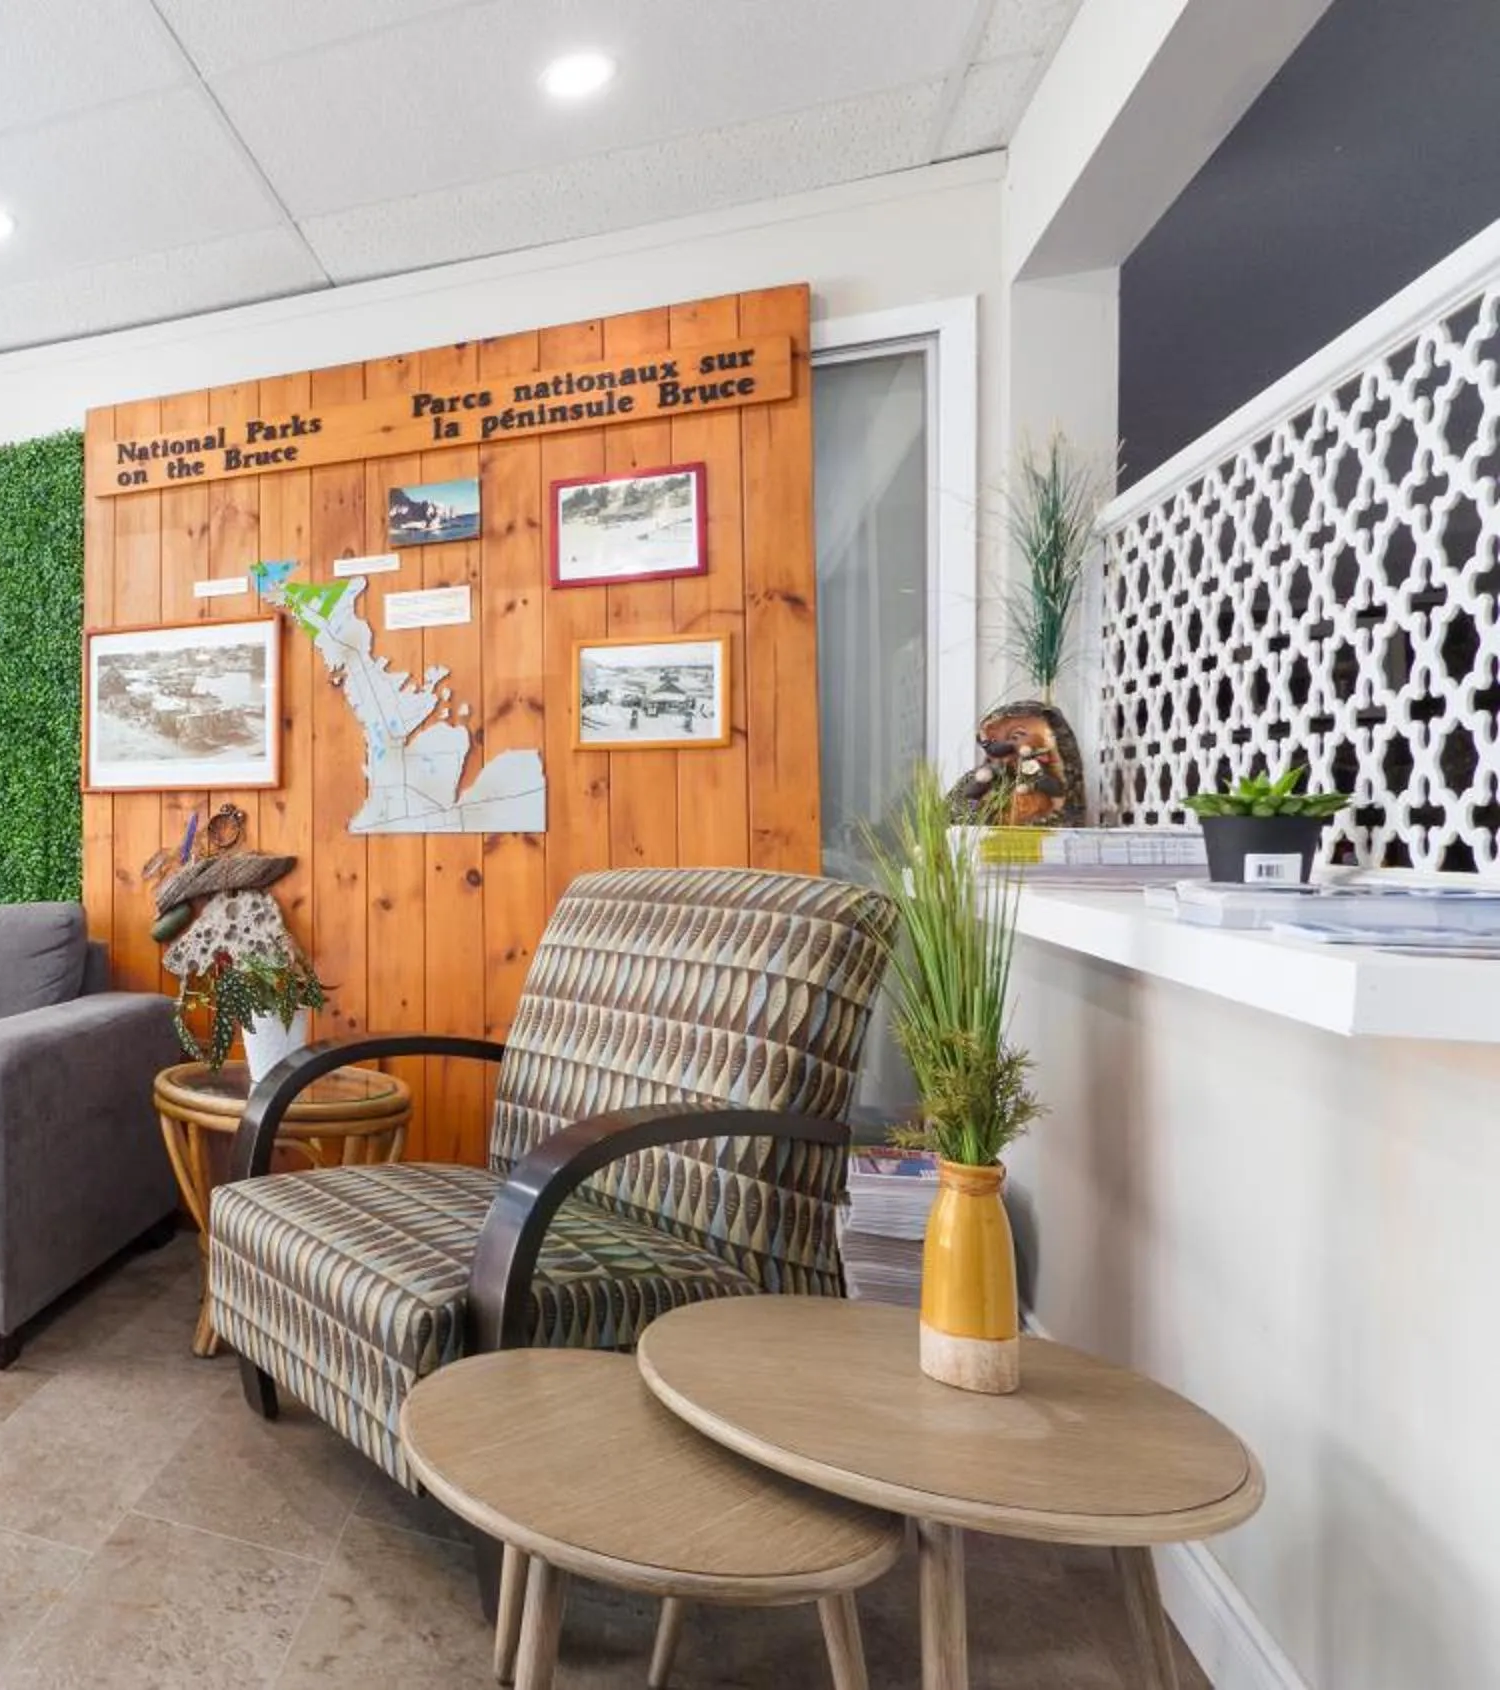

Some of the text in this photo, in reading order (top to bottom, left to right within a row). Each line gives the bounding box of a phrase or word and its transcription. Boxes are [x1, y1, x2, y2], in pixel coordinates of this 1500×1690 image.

[411, 348, 755, 418] Parcs nationaux sur
[432, 375, 755, 440] la péninsule Bruce
[117, 414, 323, 464] National Parks
[117, 445, 299, 487] on the Bruce
